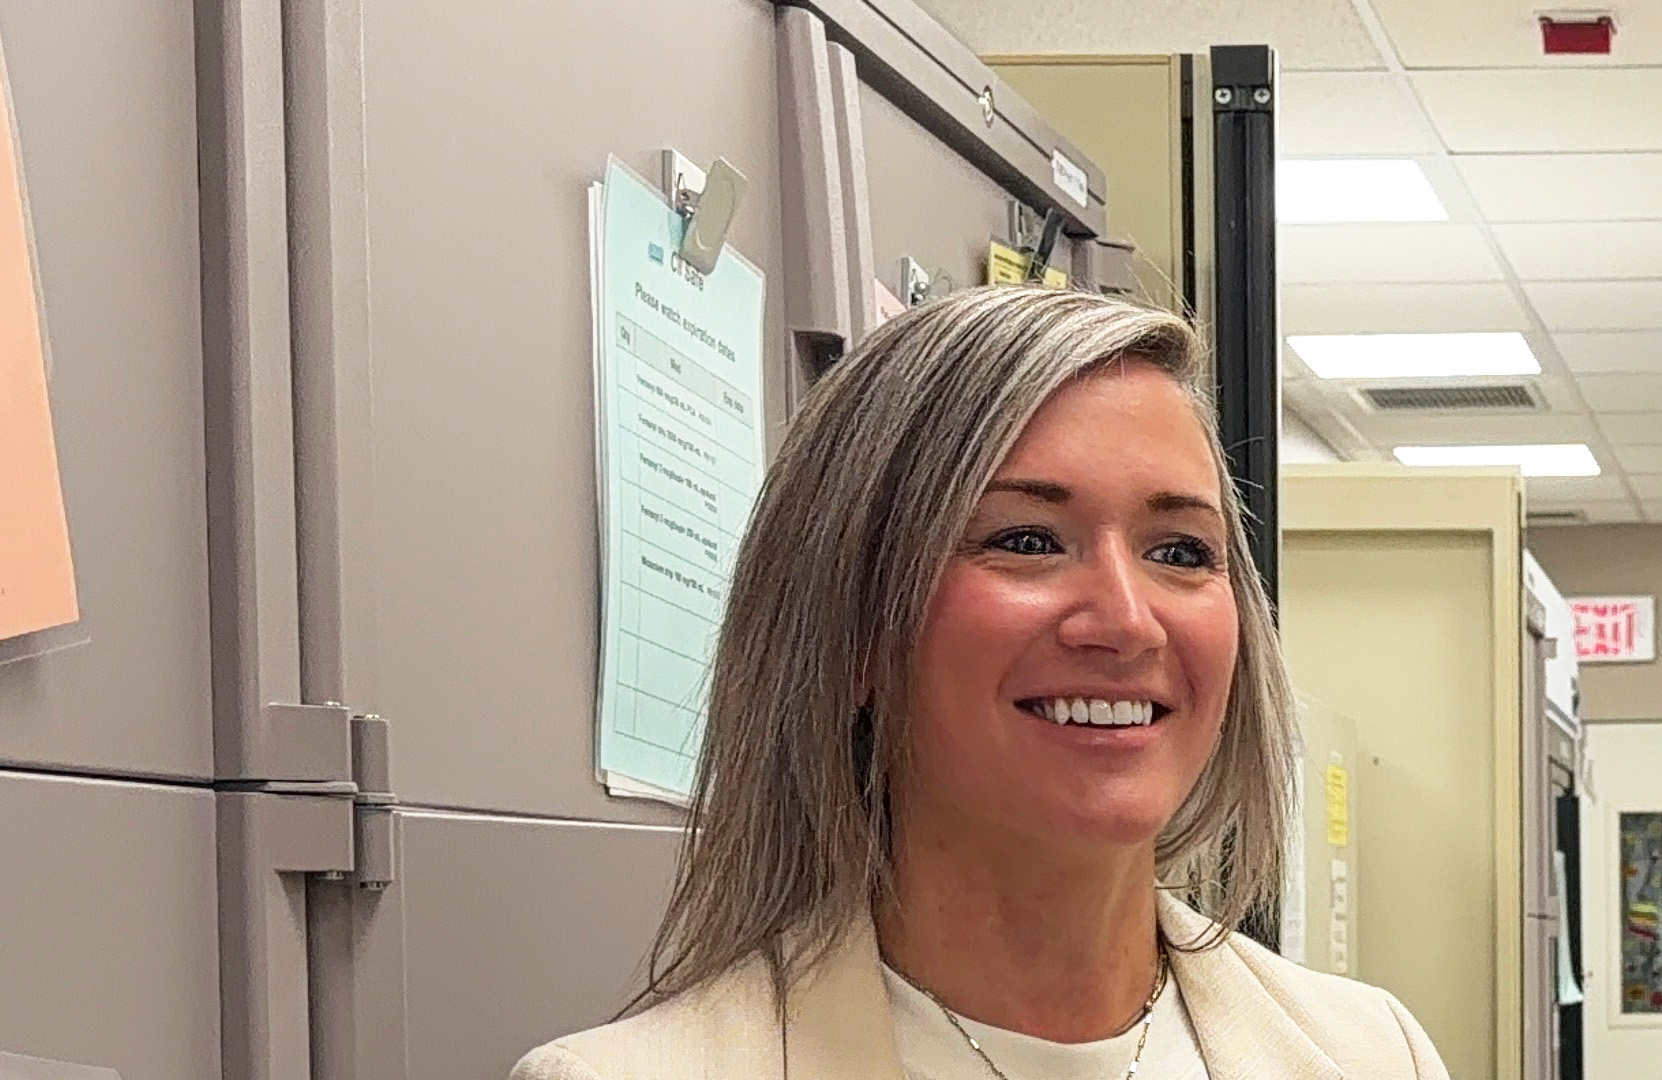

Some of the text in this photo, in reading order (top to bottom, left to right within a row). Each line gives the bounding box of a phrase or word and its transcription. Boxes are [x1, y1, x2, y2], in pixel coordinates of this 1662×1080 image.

[634, 281, 736, 363] Please watch expiration dates
[1572, 602, 1636, 657] EXIT
